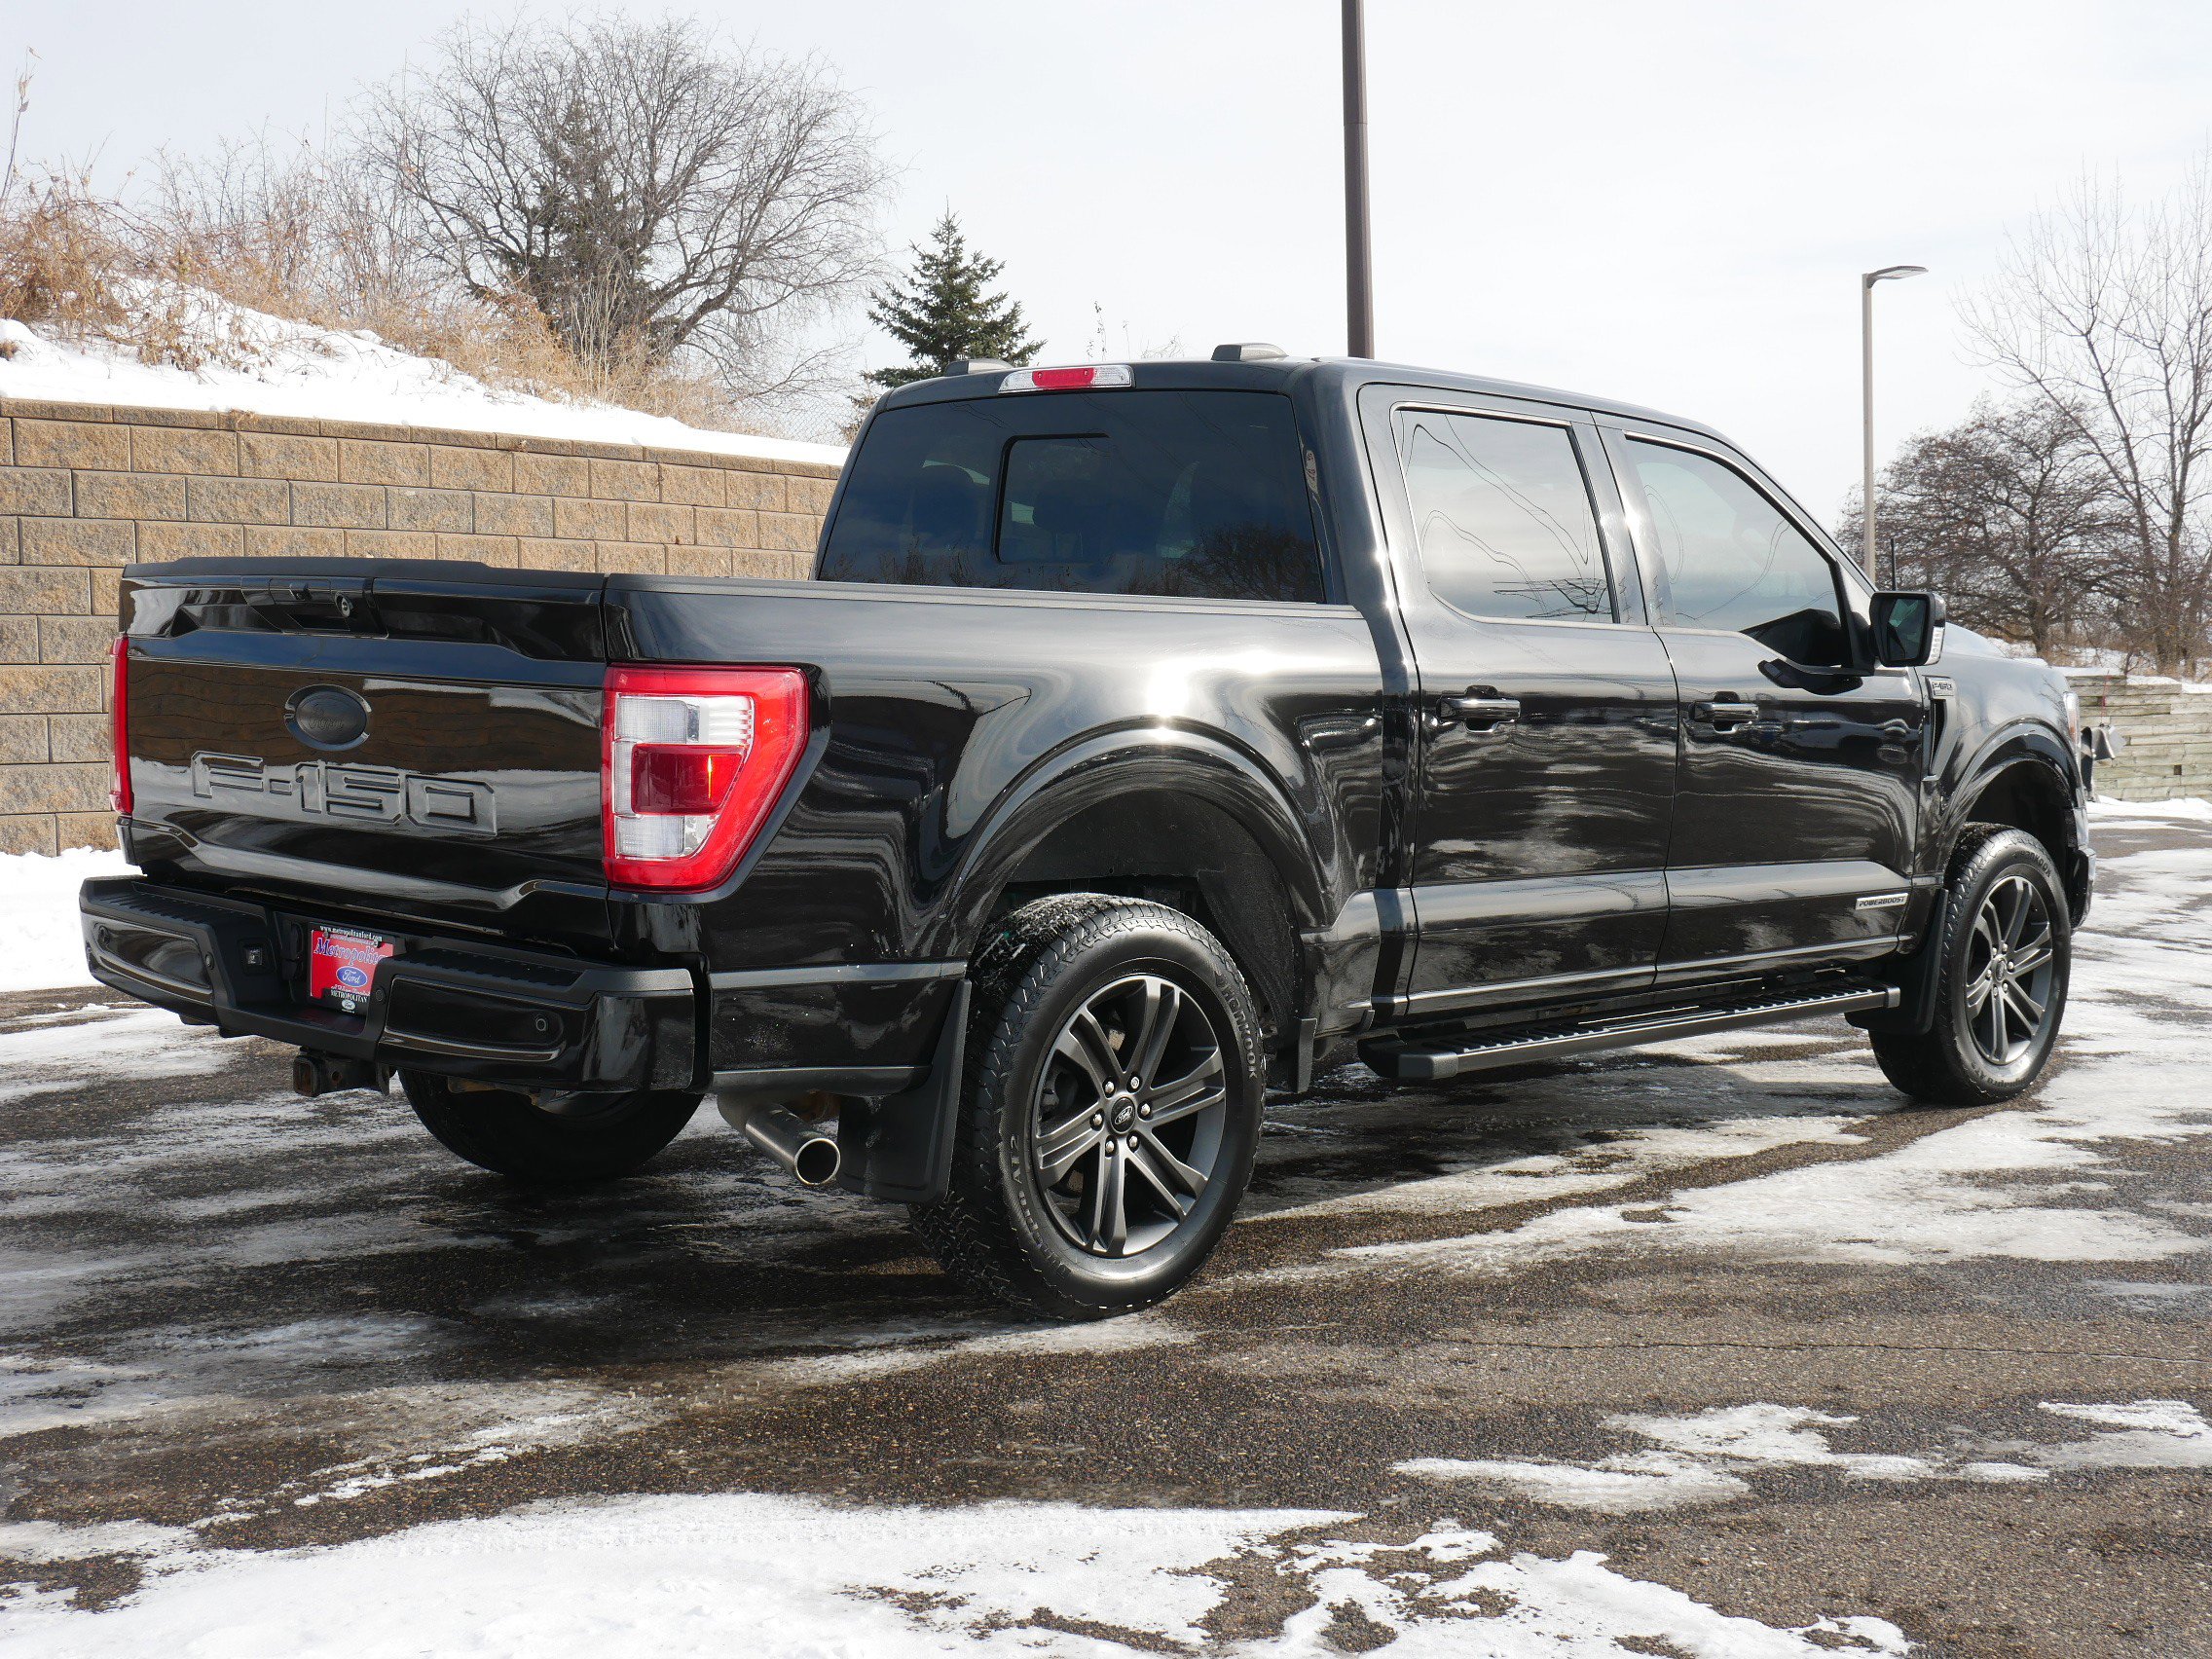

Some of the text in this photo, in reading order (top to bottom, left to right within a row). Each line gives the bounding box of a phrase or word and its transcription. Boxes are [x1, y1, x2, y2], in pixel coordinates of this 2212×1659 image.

[191, 750, 498, 836] F-150
[1859, 897, 1904, 906] POWERBOOST
[313, 937, 387, 966] Metropolit
[342, 969, 361, 984] Ford
[331, 989, 368, 1003] METROPOLITAN
